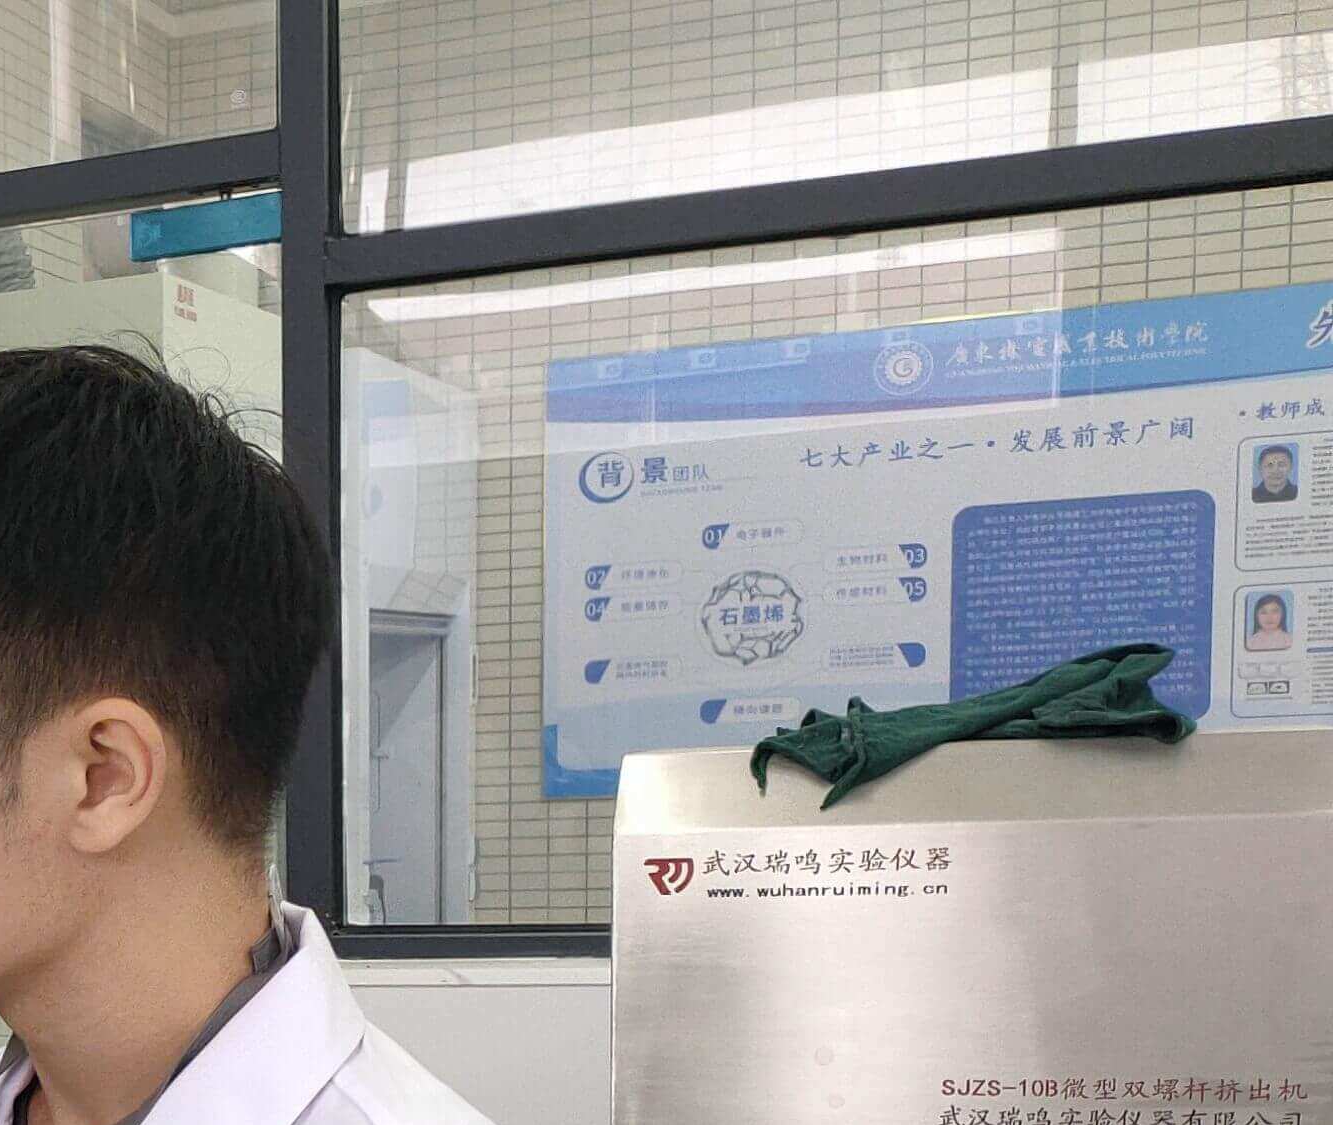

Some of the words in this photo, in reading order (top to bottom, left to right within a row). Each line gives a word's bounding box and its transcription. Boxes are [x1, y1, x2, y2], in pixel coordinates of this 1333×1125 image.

[906, 581, 925, 599] 05
[719, 604, 785, 627] 石墨烯
[702, 846, 953, 876] 武汉瑞鸣实验仪器
